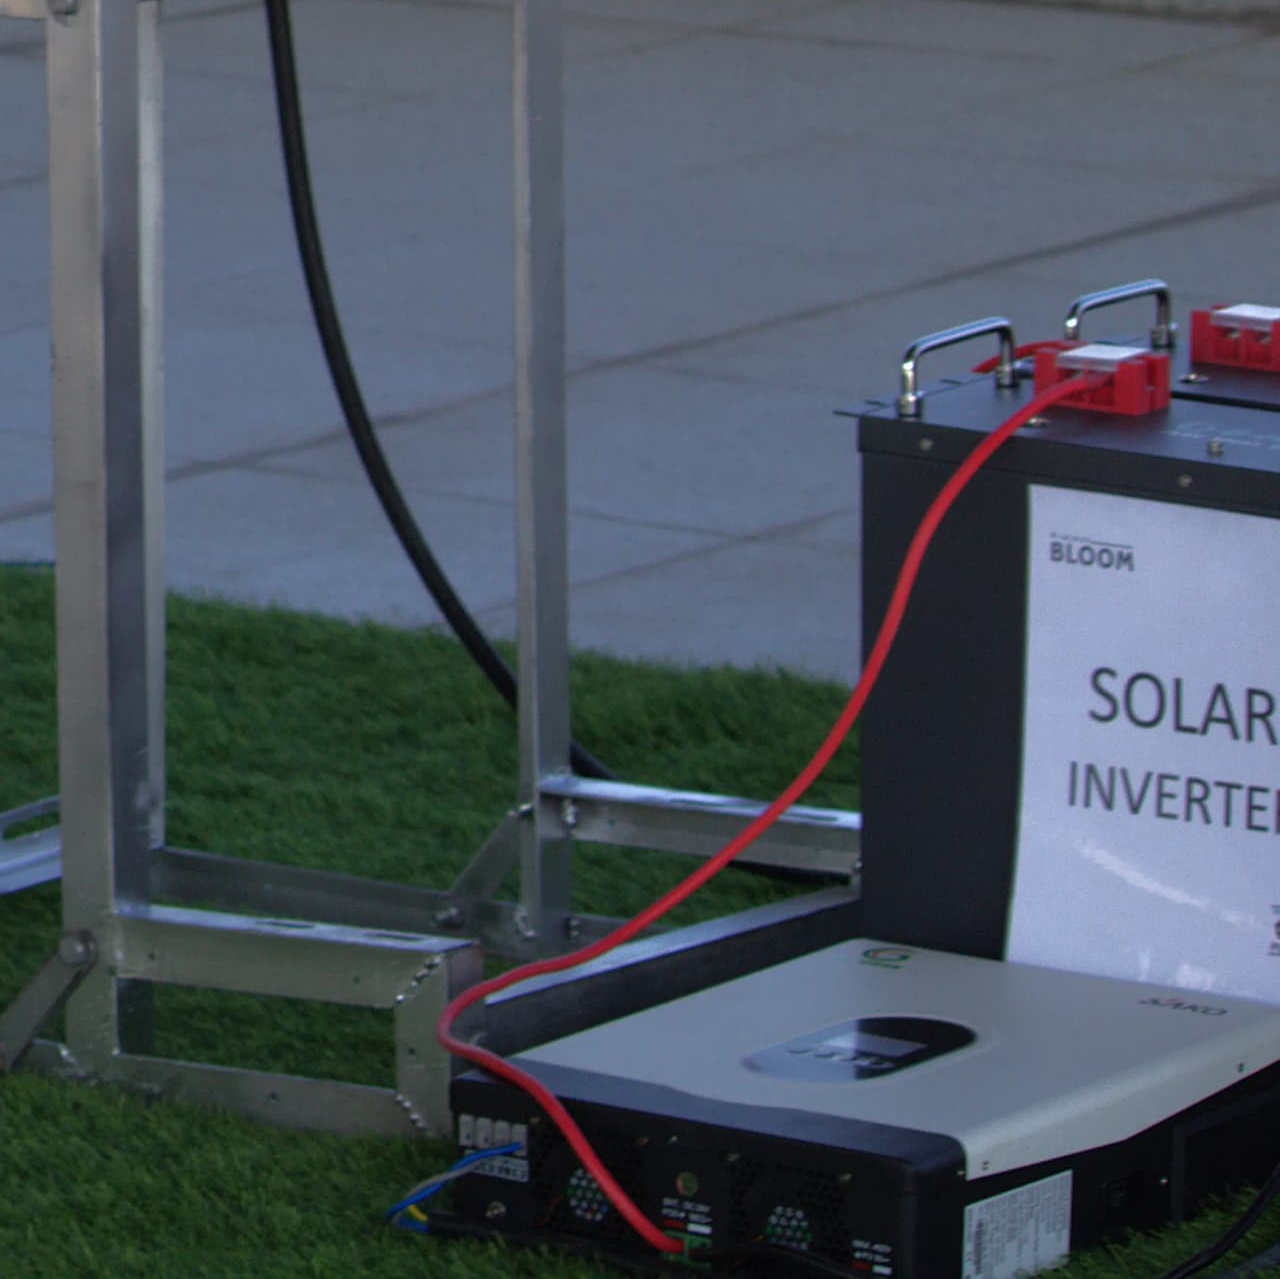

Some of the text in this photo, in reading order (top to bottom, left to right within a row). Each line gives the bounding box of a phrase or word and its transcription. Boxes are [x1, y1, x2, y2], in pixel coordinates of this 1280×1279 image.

[1049, 541, 1135, 573] BLOOM
[1088, 666, 1279, 747] SOLAR
[1067, 760, 1280, 836] INVERTE
